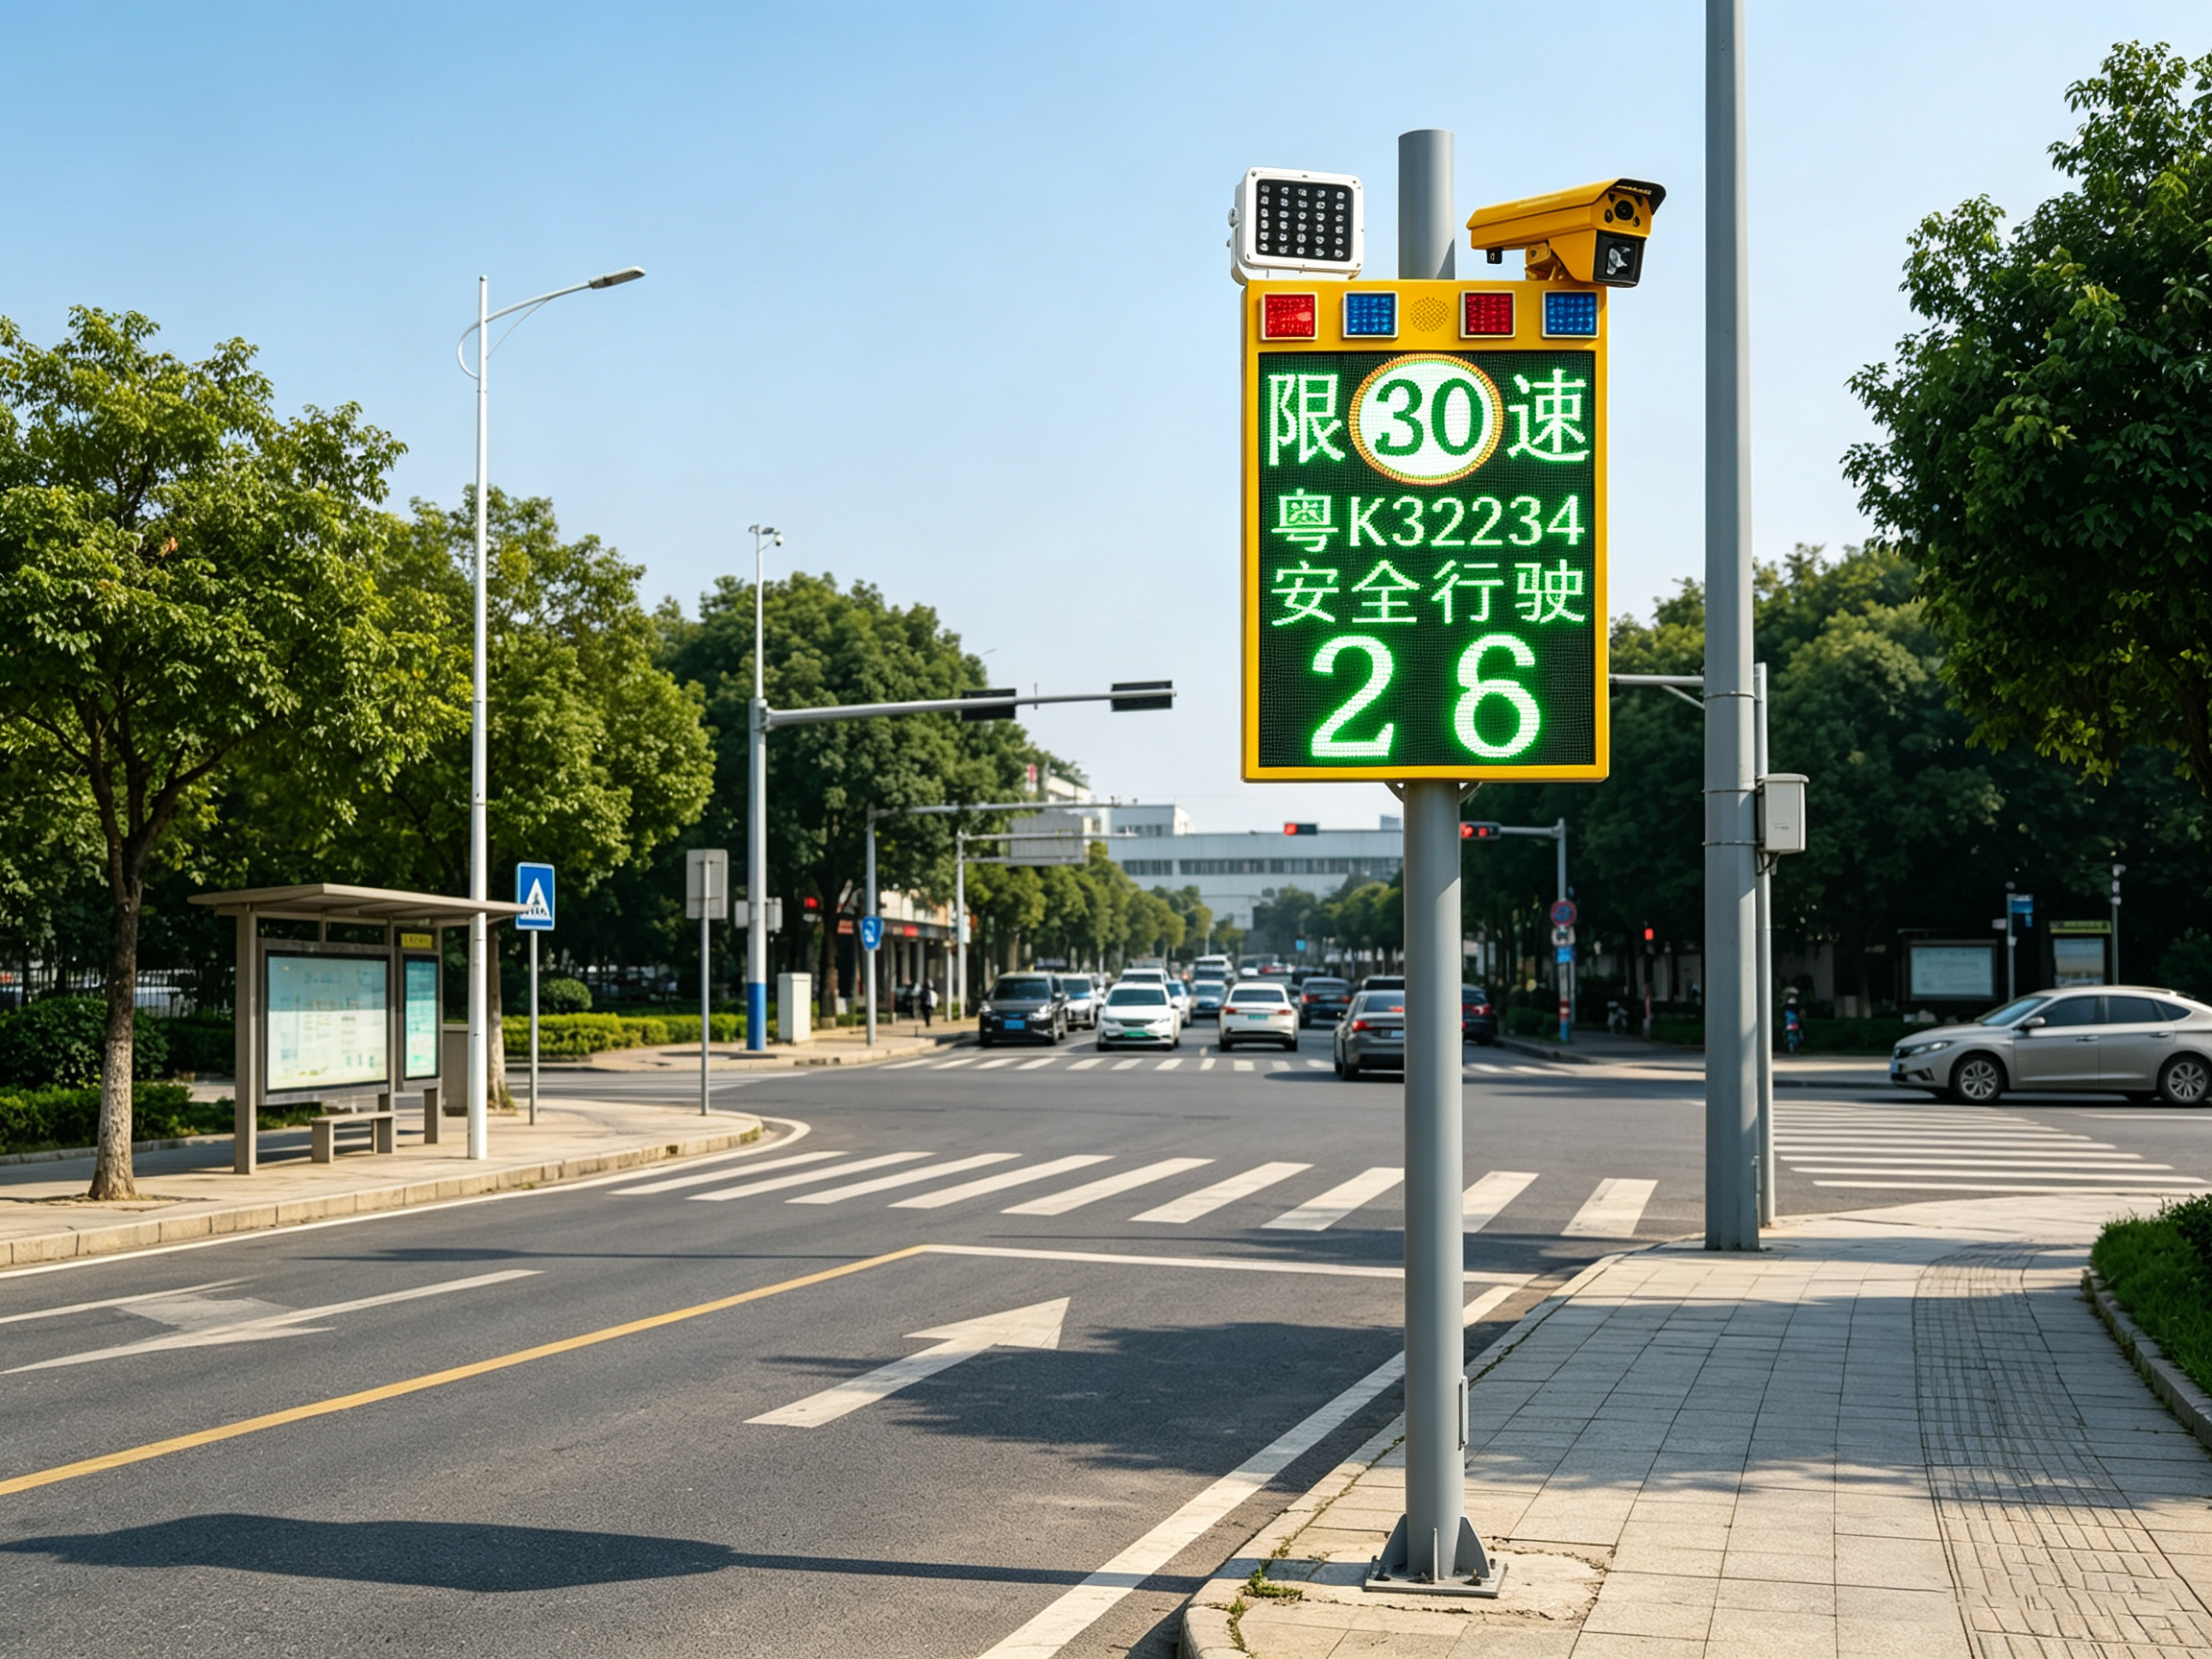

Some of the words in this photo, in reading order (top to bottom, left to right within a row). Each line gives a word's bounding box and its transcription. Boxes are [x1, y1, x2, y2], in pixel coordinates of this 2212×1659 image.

[1267, 373, 1346, 467] 限
[1375, 378, 1486, 458] 30
[1507, 368, 1590, 463] 速
[1271, 559, 1586, 626] 安全行驶
